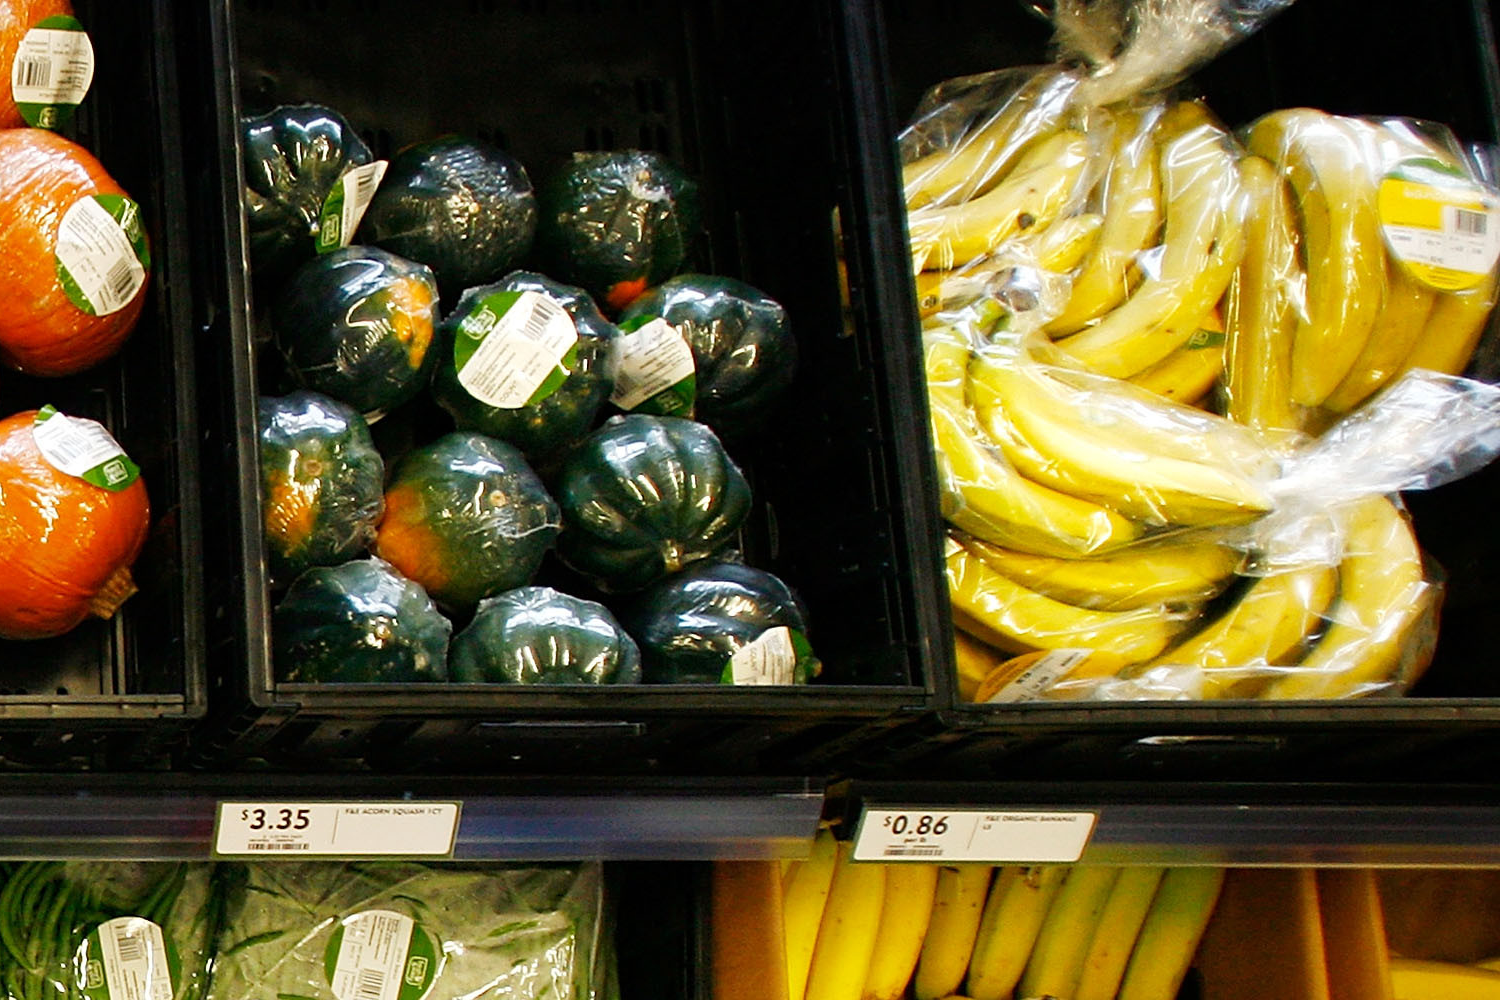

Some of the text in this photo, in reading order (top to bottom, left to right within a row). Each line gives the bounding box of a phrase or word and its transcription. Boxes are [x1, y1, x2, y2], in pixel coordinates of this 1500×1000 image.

[242, 808, 311, 830] $3.35
[392, 808, 425, 816] SQUASH
[883, 815, 949, 835] $0.86
